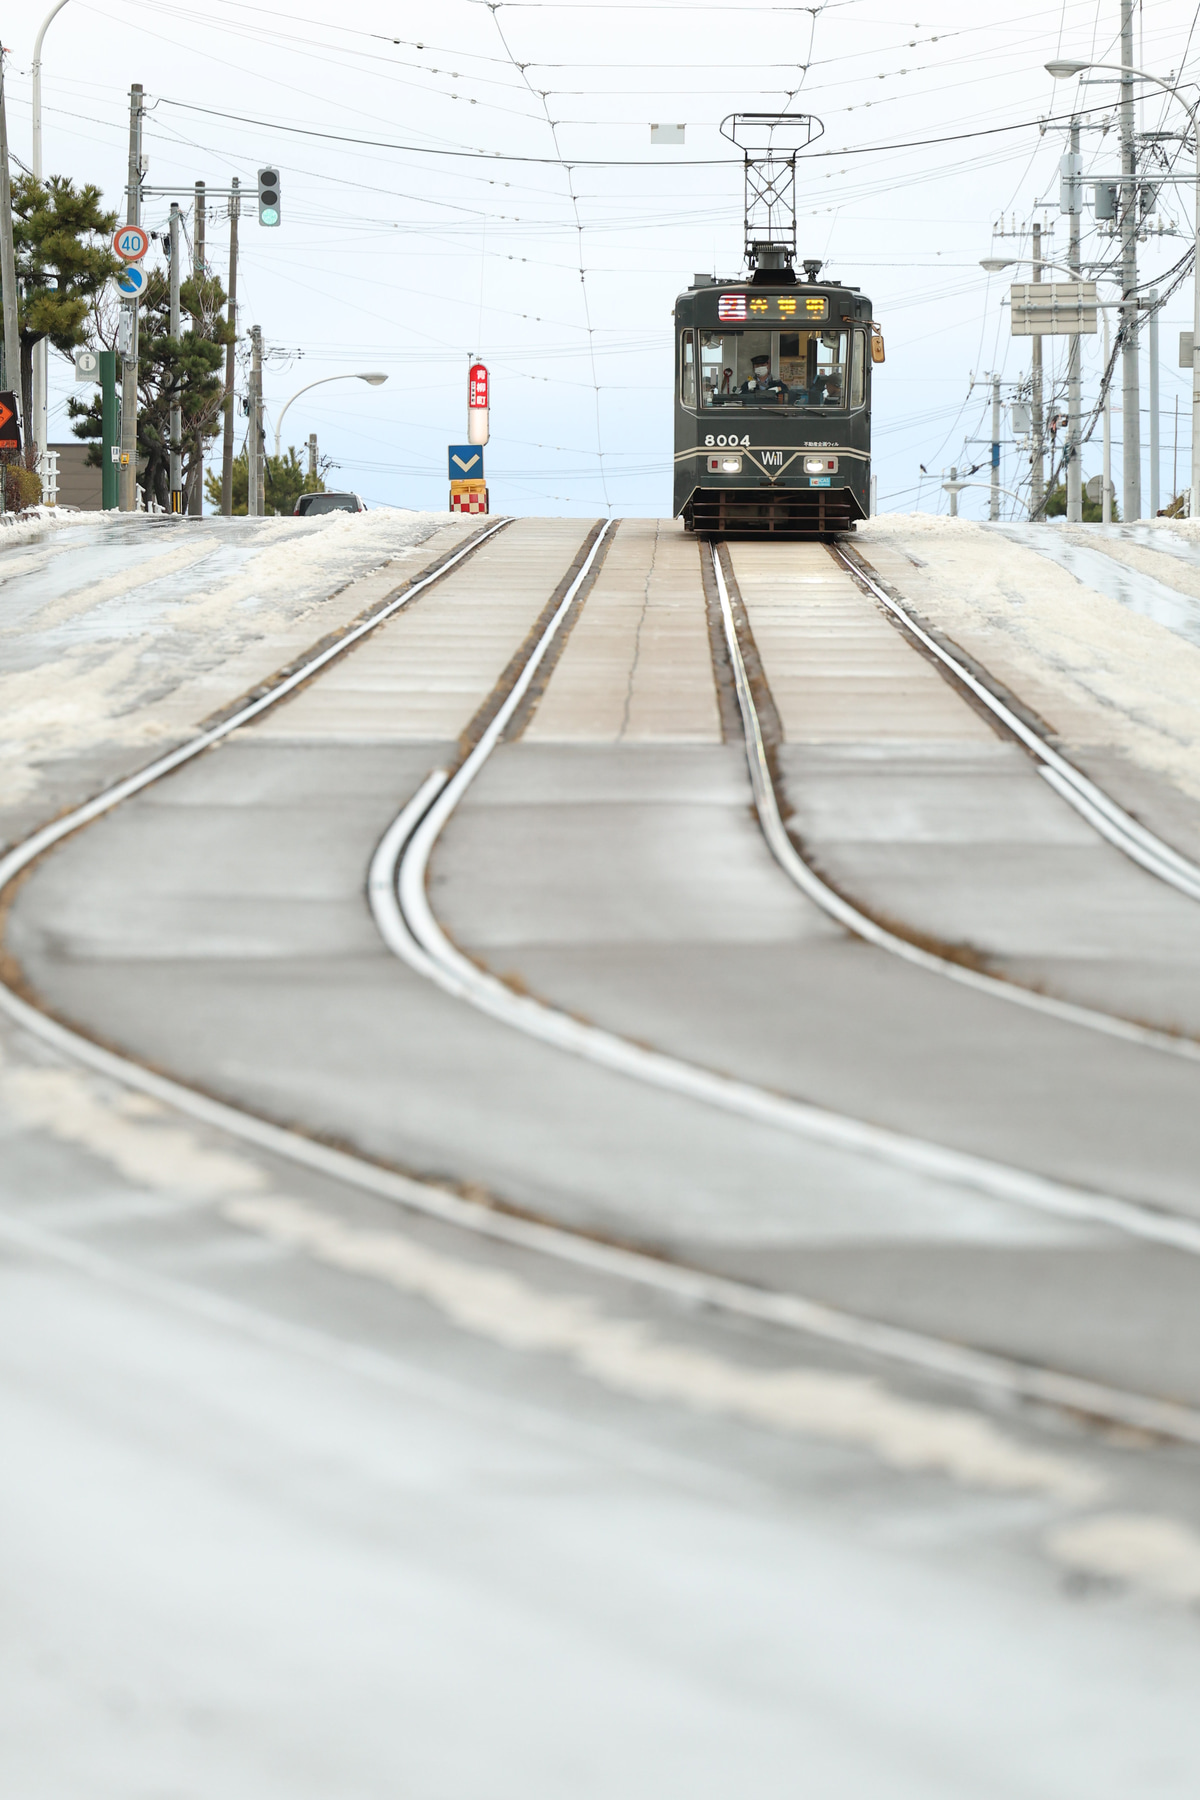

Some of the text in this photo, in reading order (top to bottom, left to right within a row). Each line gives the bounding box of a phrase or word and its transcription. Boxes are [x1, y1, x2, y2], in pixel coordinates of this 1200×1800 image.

[122, 235, 141, 252] 40
[476, 370, 486, 405] 青柳町
[704, 434, 751, 447] 8004
[761, 451, 783, 466] Will
